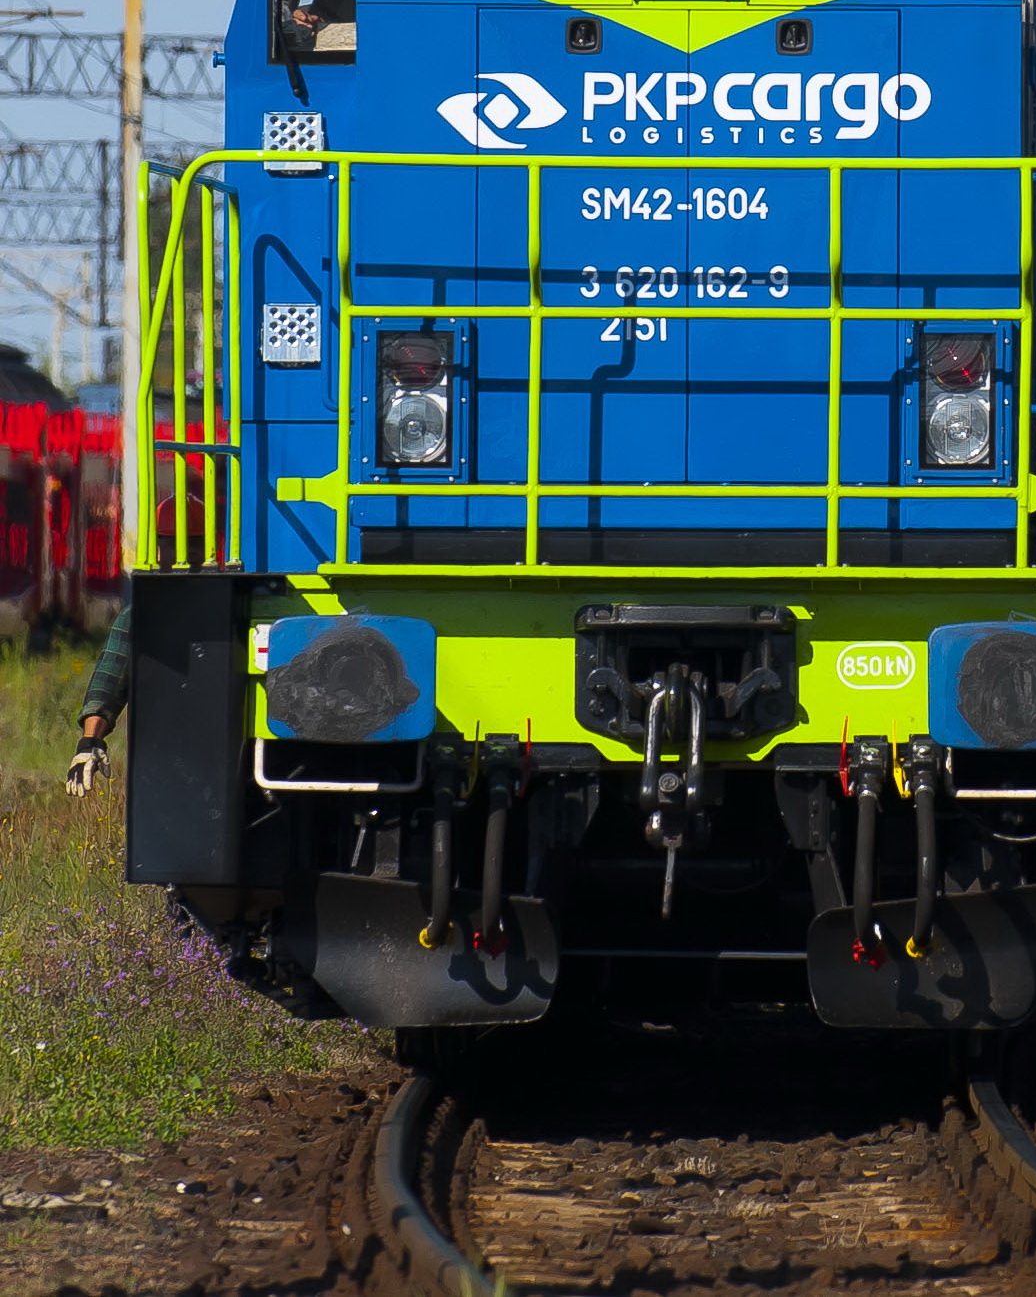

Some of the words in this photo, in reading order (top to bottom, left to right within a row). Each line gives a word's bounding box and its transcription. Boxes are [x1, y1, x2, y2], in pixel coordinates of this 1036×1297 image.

[583, 127, 823, 144] LOGISTICS
[581, 187, 769, 221] SM42-1604
[579, 265, 601, 299] 3
[615, 265, 679, 299] 620
[693, 265, 790, 299] 162-9
